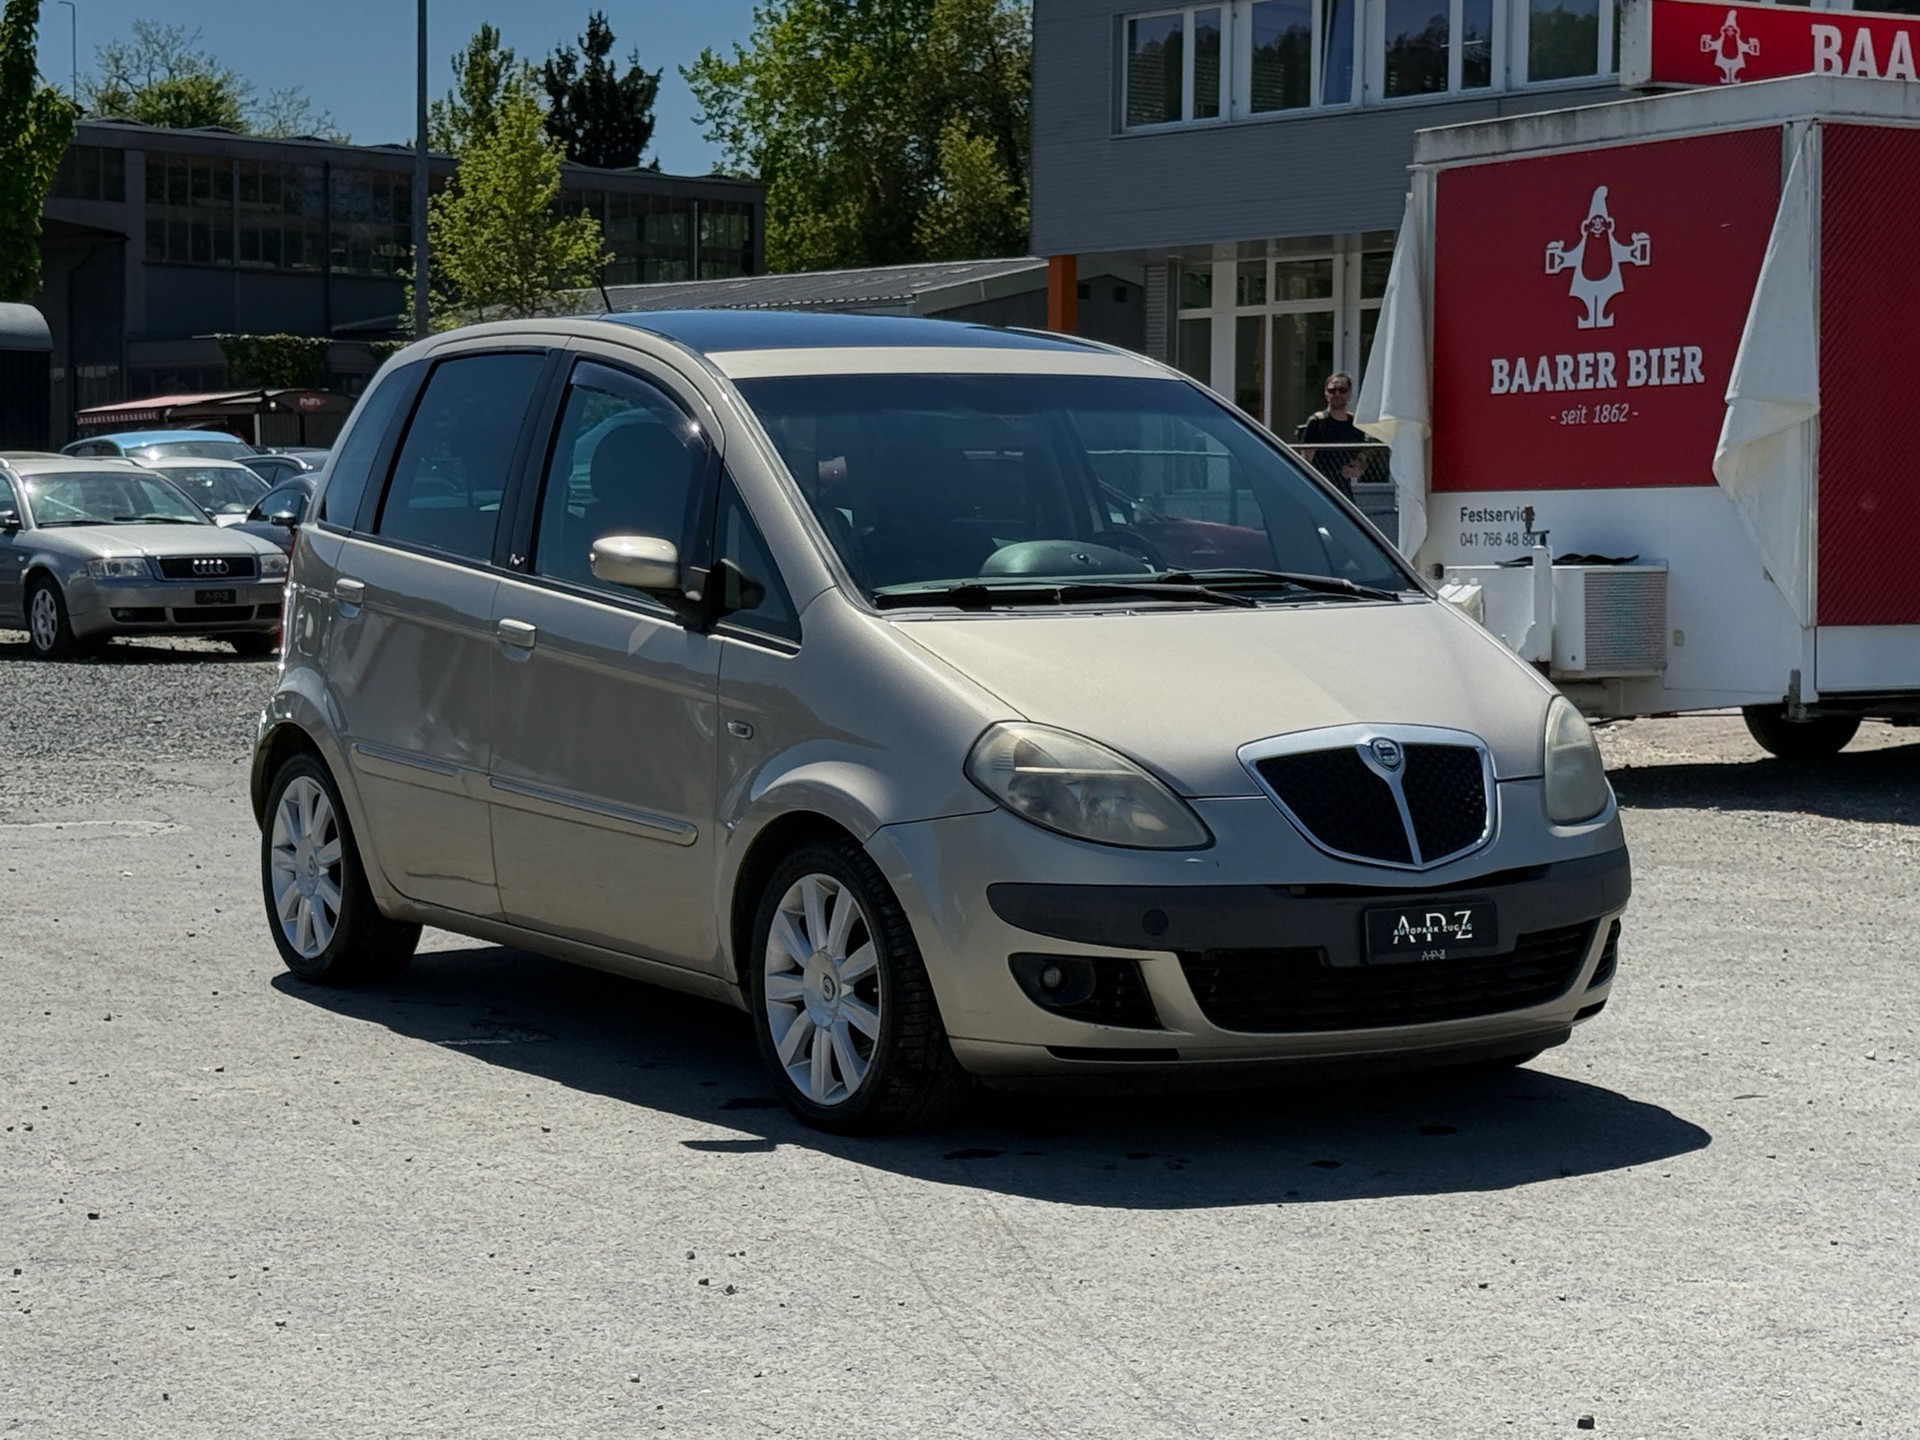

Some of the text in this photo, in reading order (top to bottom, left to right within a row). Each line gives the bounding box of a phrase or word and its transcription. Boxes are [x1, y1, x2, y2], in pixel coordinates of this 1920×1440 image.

[1490, 345, 1705, 395] BAARER BIER
[1559, 404, 1587, 425] seit
[1592, 403, 1629, 424] 1862
[1460, 506, 1535, 523] Festservic
[1460, 532, 1479, 547] 041
[1482, 532, 1502, 547] 766
[1504, 531, 1519, 547] 48
